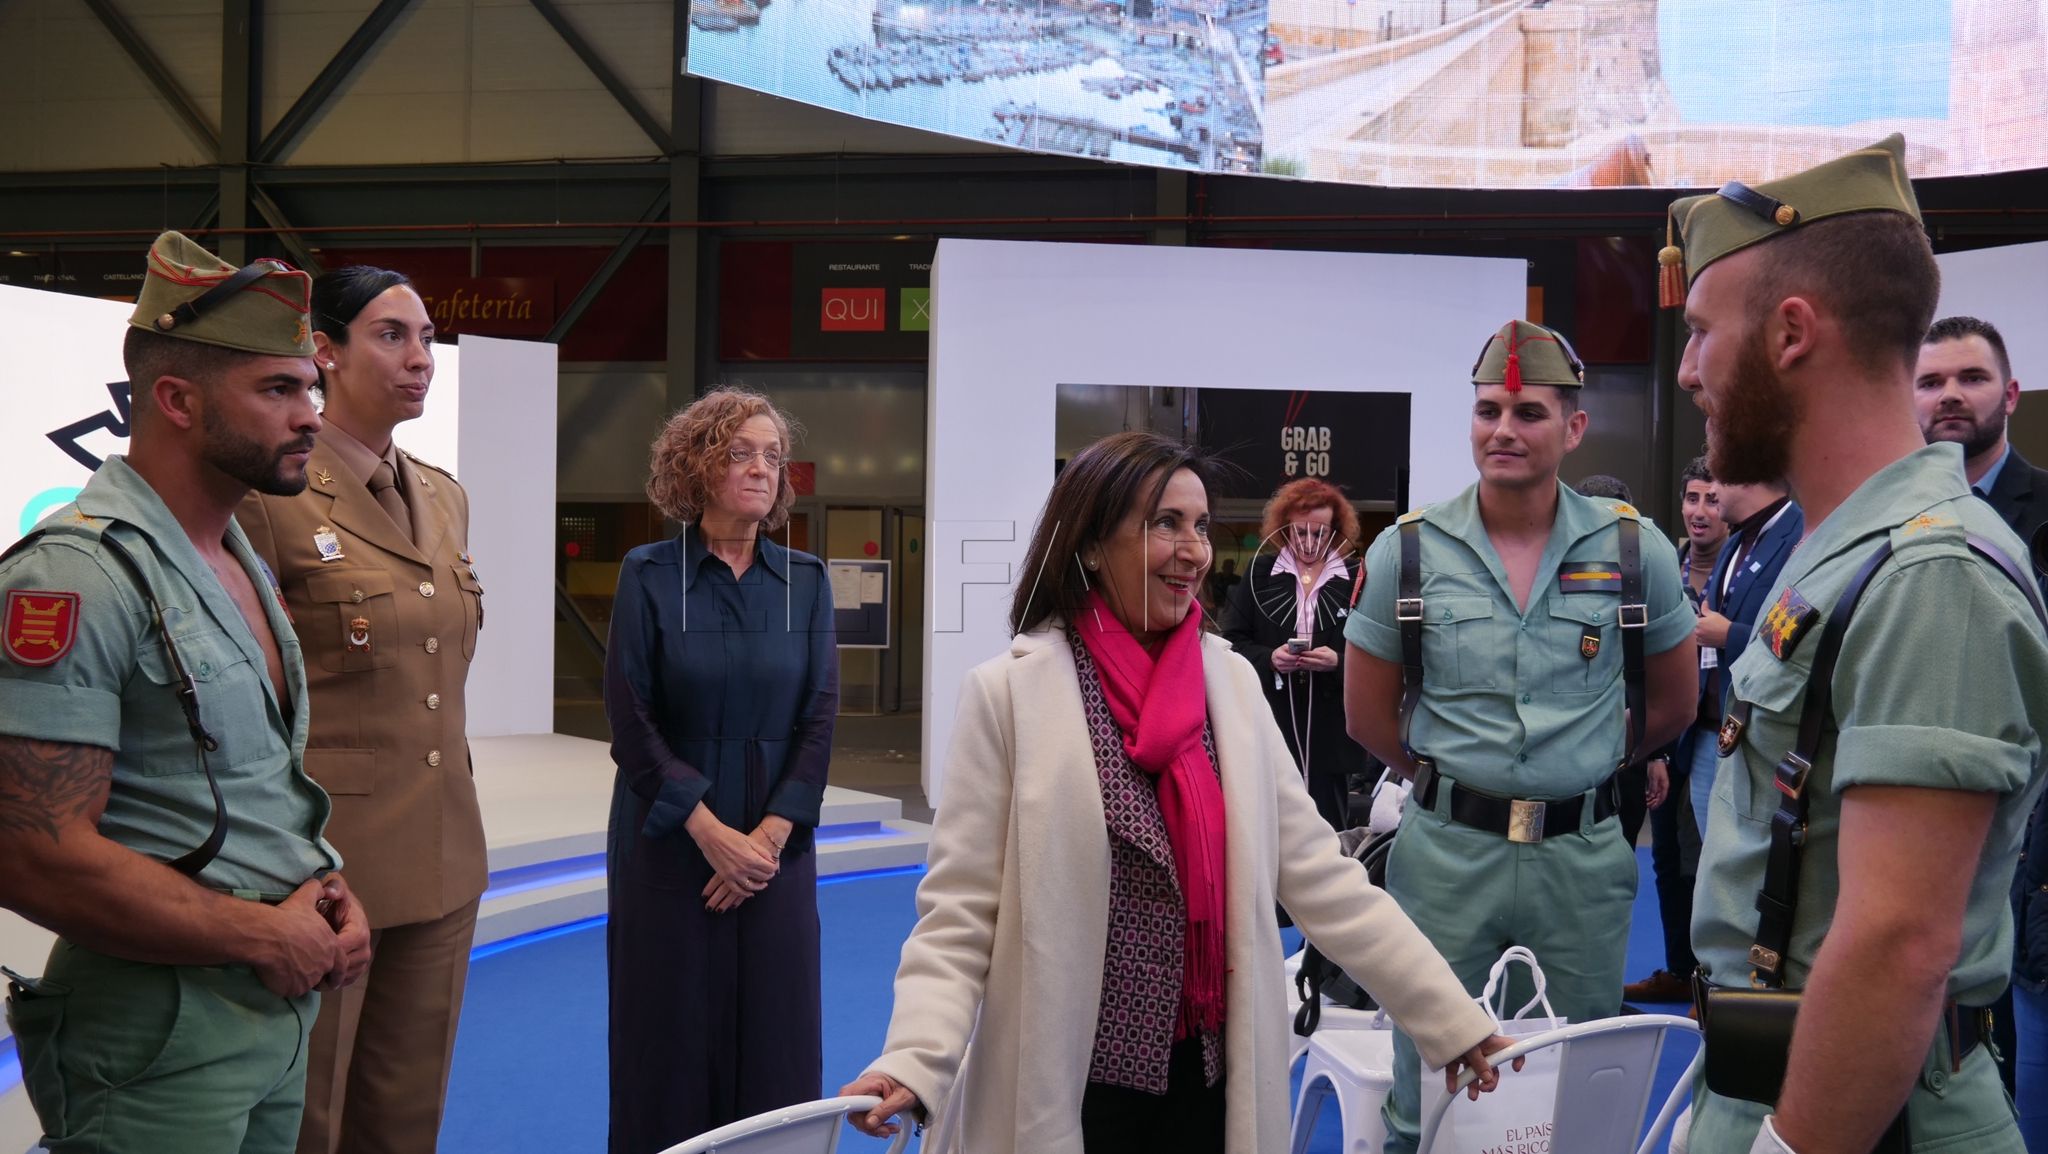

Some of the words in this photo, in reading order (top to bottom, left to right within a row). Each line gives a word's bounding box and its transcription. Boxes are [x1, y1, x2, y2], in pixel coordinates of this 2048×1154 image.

[103, 273, 145, 281] CASTELLANO
[828, 263, 881, 271] RESTAURANTE
[423, 289, 533, 332] afetería
[825, 298, 878, 321] QUI
[1281, 426, 1331, 451] GRAB
[1284, 451, 1299, 476] &
[1305, 451, 1330, 476] GO
[1506, 1128, 1522, 1142] EL
[1525, 1122, 1553, 1139] PAÍS
